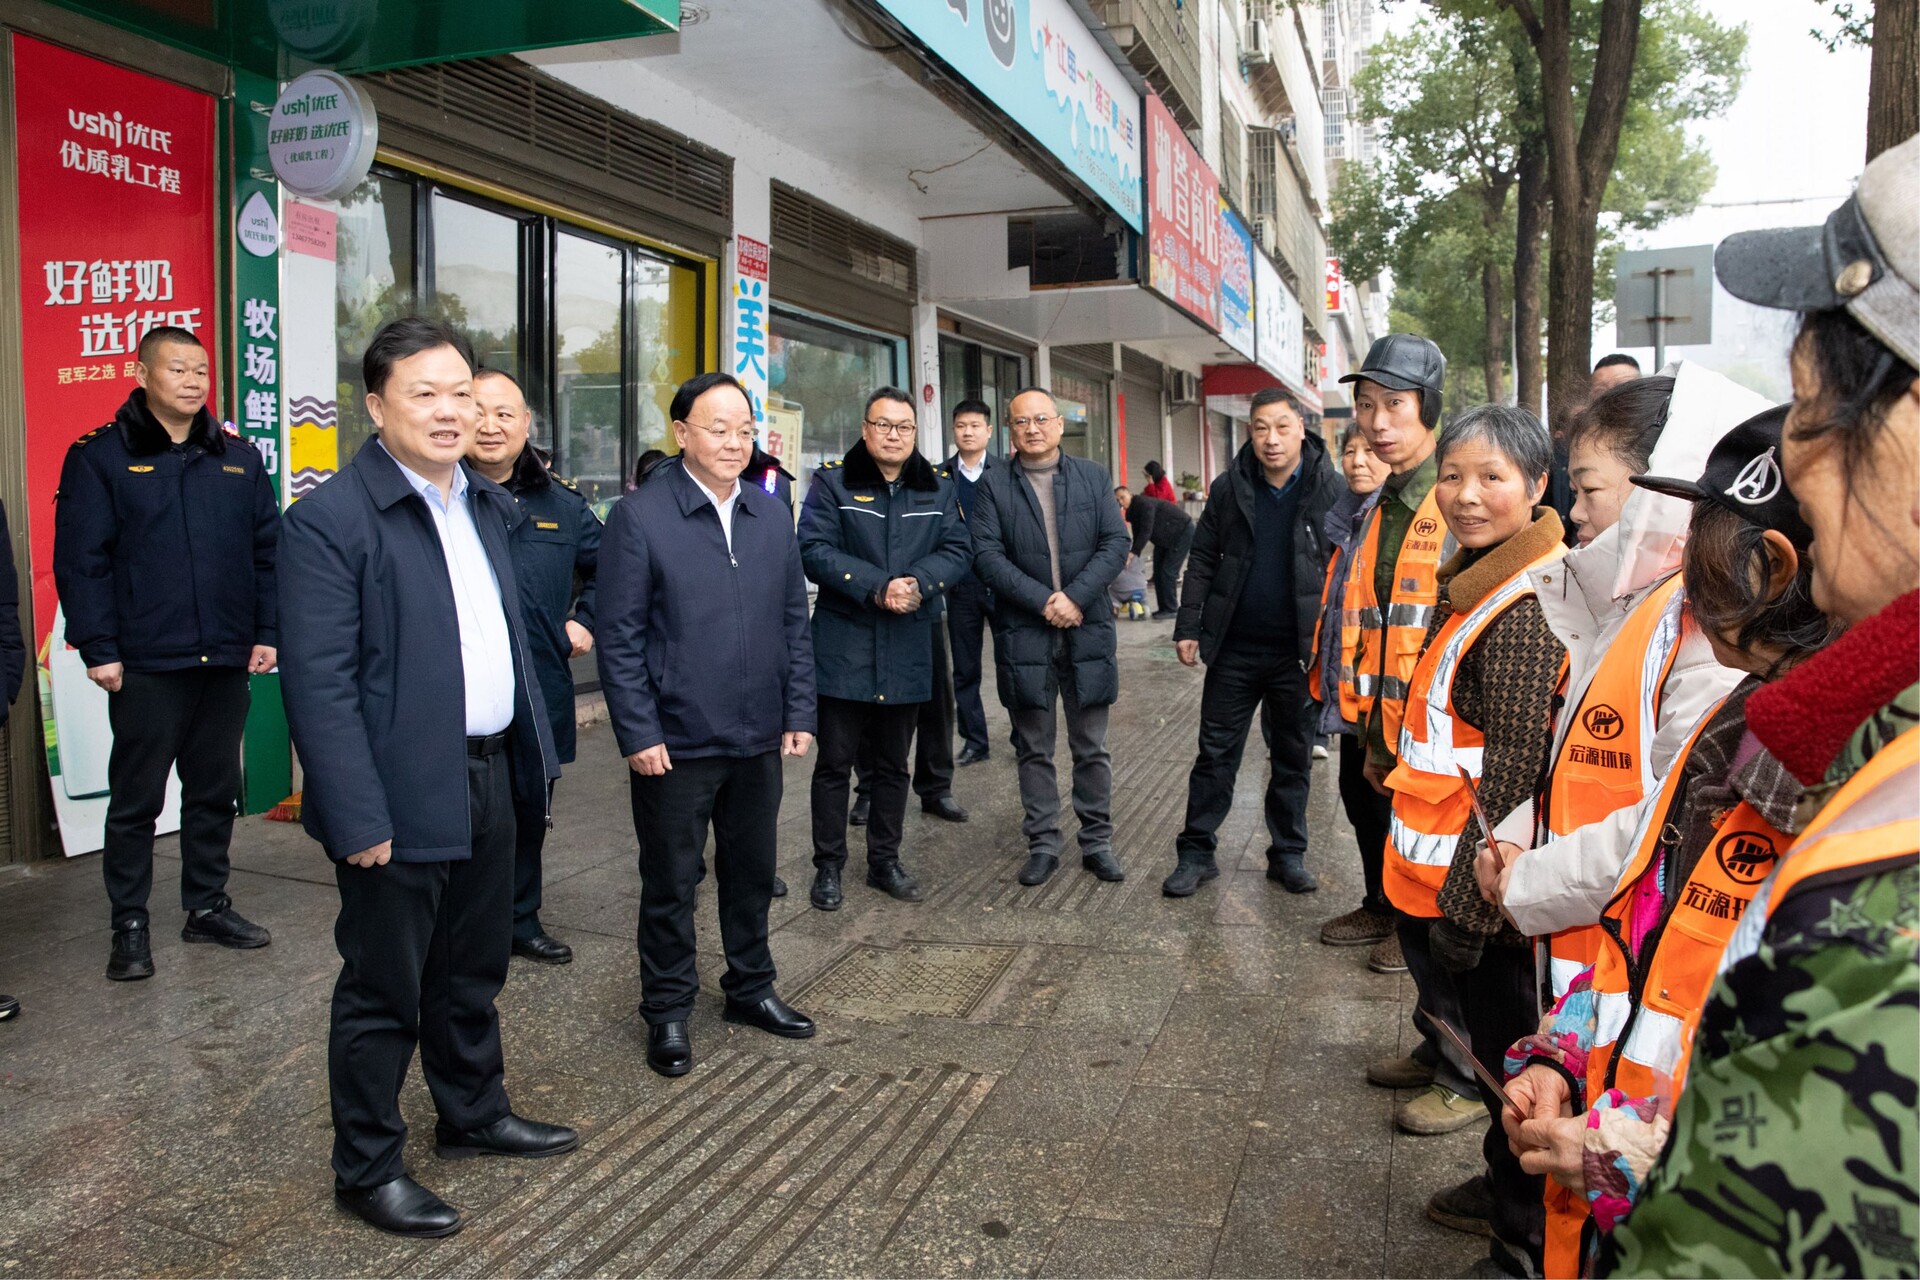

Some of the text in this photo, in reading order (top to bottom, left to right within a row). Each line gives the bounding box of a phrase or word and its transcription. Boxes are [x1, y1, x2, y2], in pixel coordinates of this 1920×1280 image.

[312, 94, 338, 112] 优氏
[126, 121, 172, 155] 优氏
[270, 120, 350, 145] 好鲜奶 选优氏
[59, 139, 181, 195] 优质乳工程
[43, 258, 173, 306] 好鲜奶
[58, 363, 117, 385] 冠军之选
[243, 298, 278, 476] 牧场鲜奶
[1569, 744, 1633, 772] 宏源环境
[1683, 881, 1752, 921] 宏源环
